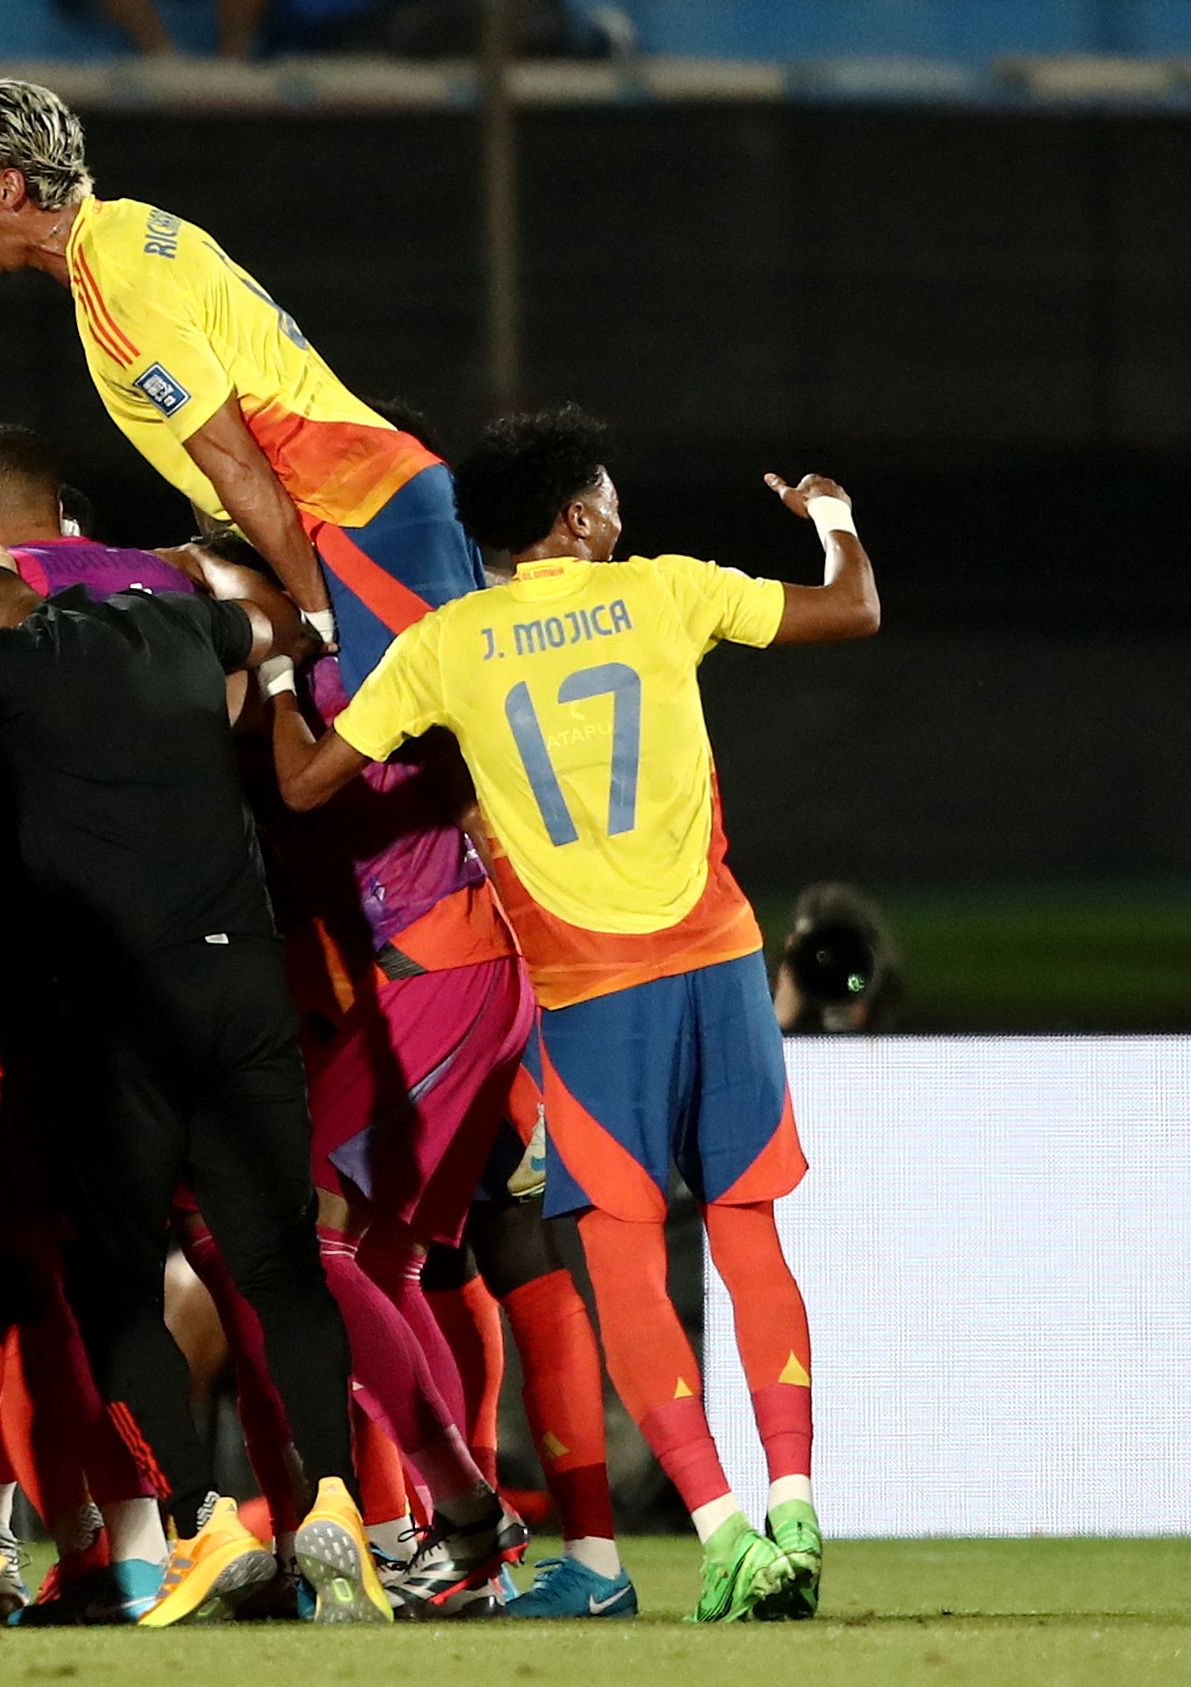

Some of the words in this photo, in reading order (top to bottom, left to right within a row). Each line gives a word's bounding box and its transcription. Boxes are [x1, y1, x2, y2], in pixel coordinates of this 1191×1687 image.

[480, 627, 505, 661] J.
[513, 598, 633, 656] MOJICA
[504, 661, 642, 848] 17
[546, 720, 613, 749] ATAPU
